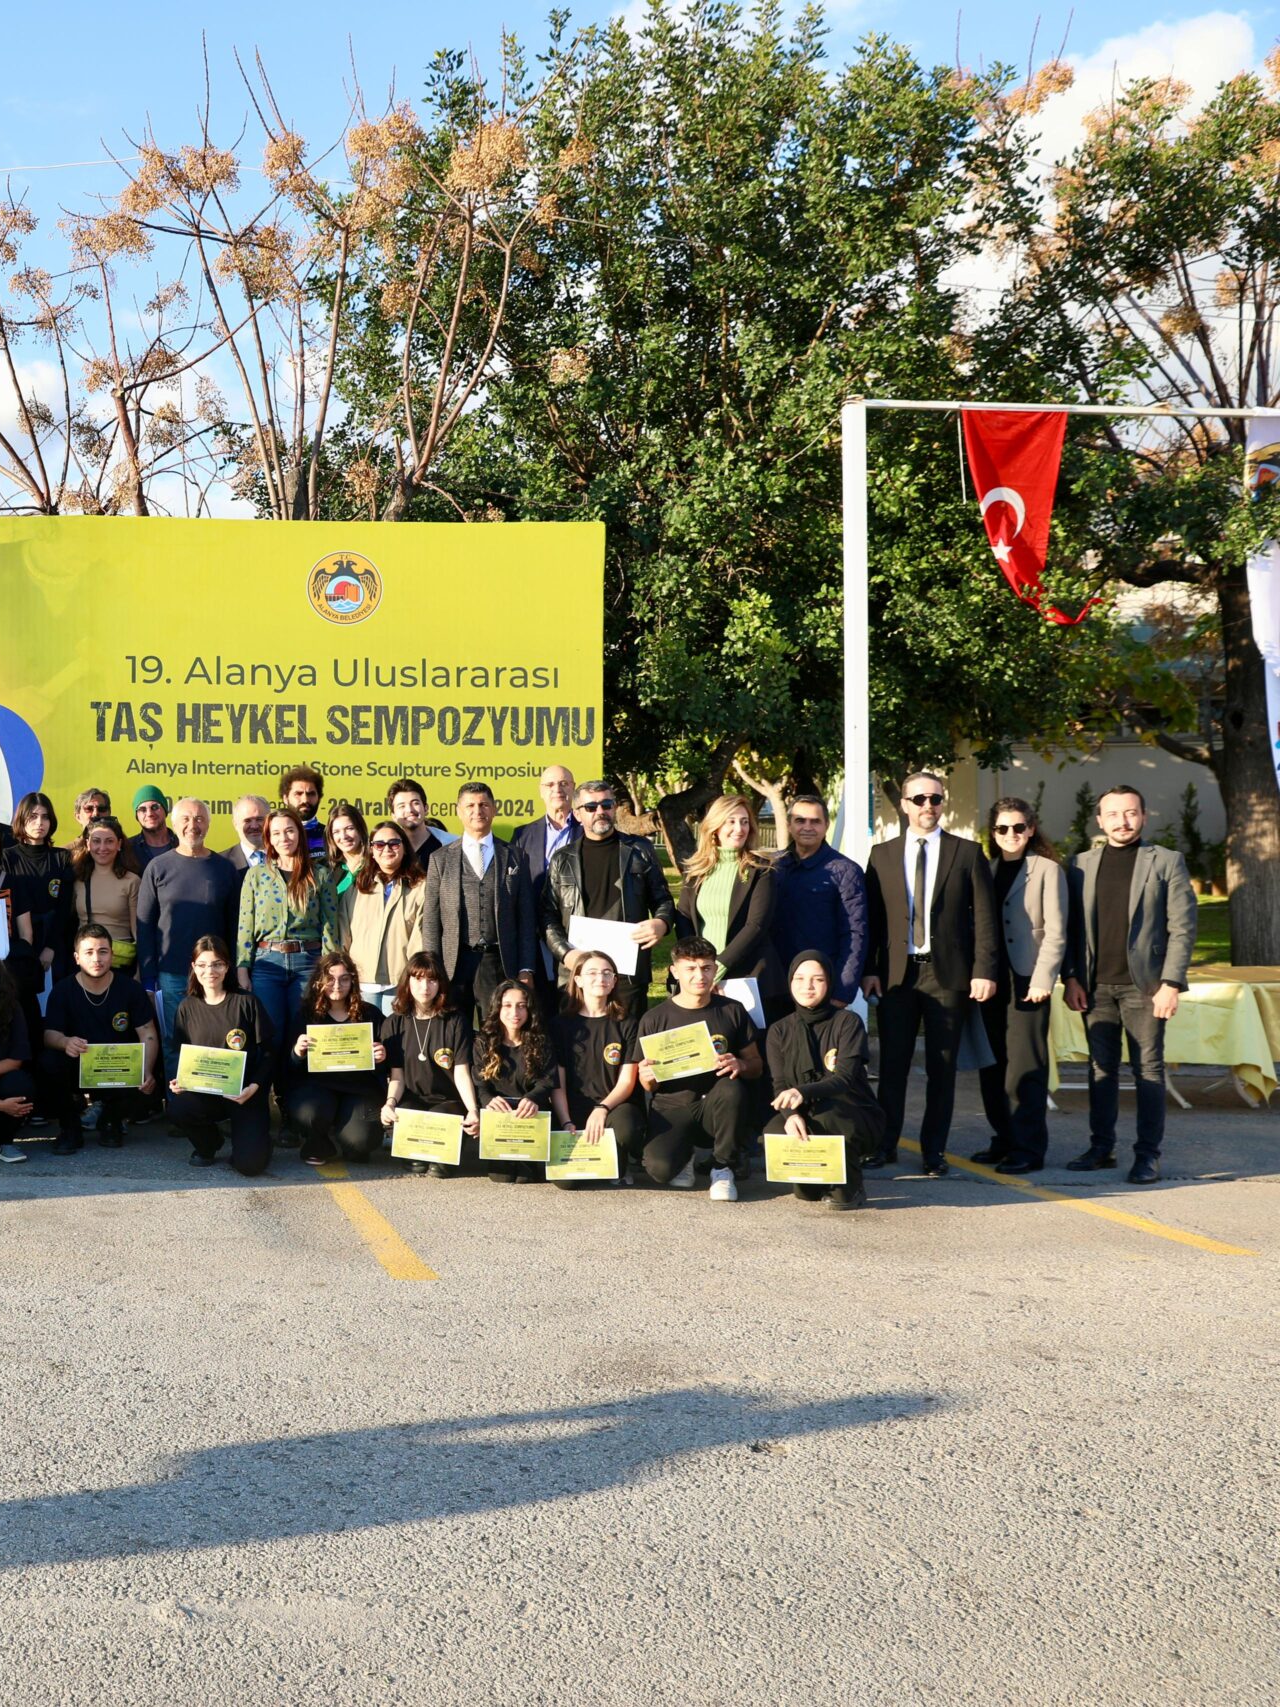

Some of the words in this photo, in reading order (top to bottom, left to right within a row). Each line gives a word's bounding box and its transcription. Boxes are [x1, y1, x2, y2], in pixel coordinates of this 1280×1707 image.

[317, 603, 339, 620] ALANYA
[125, 655, 172, 684] 19.
[184, 655, 317, 694] Alanya
[333, 657, 559, 688] Uluslararası
[90, 701, 163, 750] TAŞ
[176, 702, 317, 745] HEYKEL
[326, 704, 595, 747] SEMPOZYUMU
[126, 759, 188, 777] Alanya
[310, 761, 363, 776] Stone
[366, 762, 452, 780] Sculpture
[455, 762, 549, 781] Symposiu
[495, 799, 535, 817] 2024
